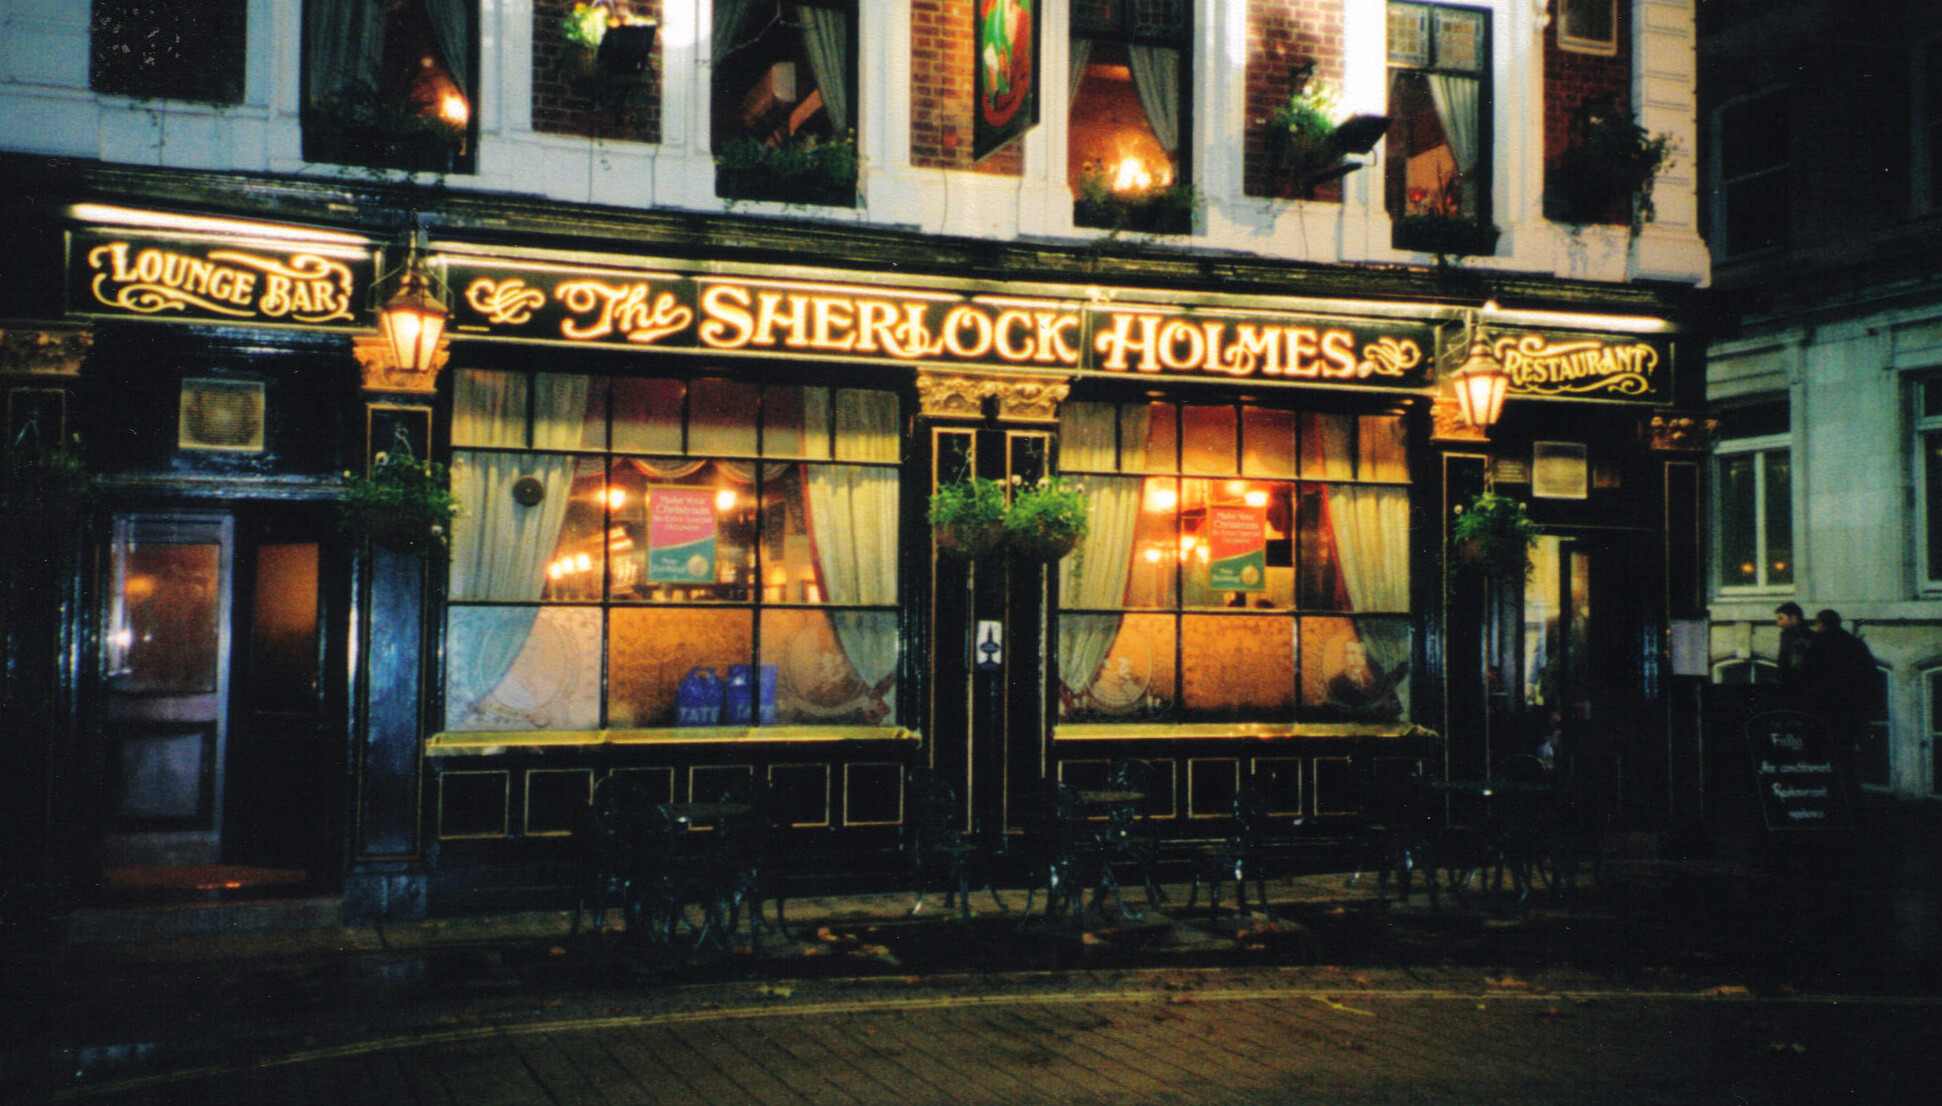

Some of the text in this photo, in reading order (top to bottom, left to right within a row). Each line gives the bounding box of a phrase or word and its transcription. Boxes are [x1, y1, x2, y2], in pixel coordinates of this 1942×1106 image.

[92, 242, 352, 317] LOUNGE BAR
[554, 279, 1358, 379] The SHERLOCK HOLMES
[1500, 343, 1655, 386] RESTAURANT
